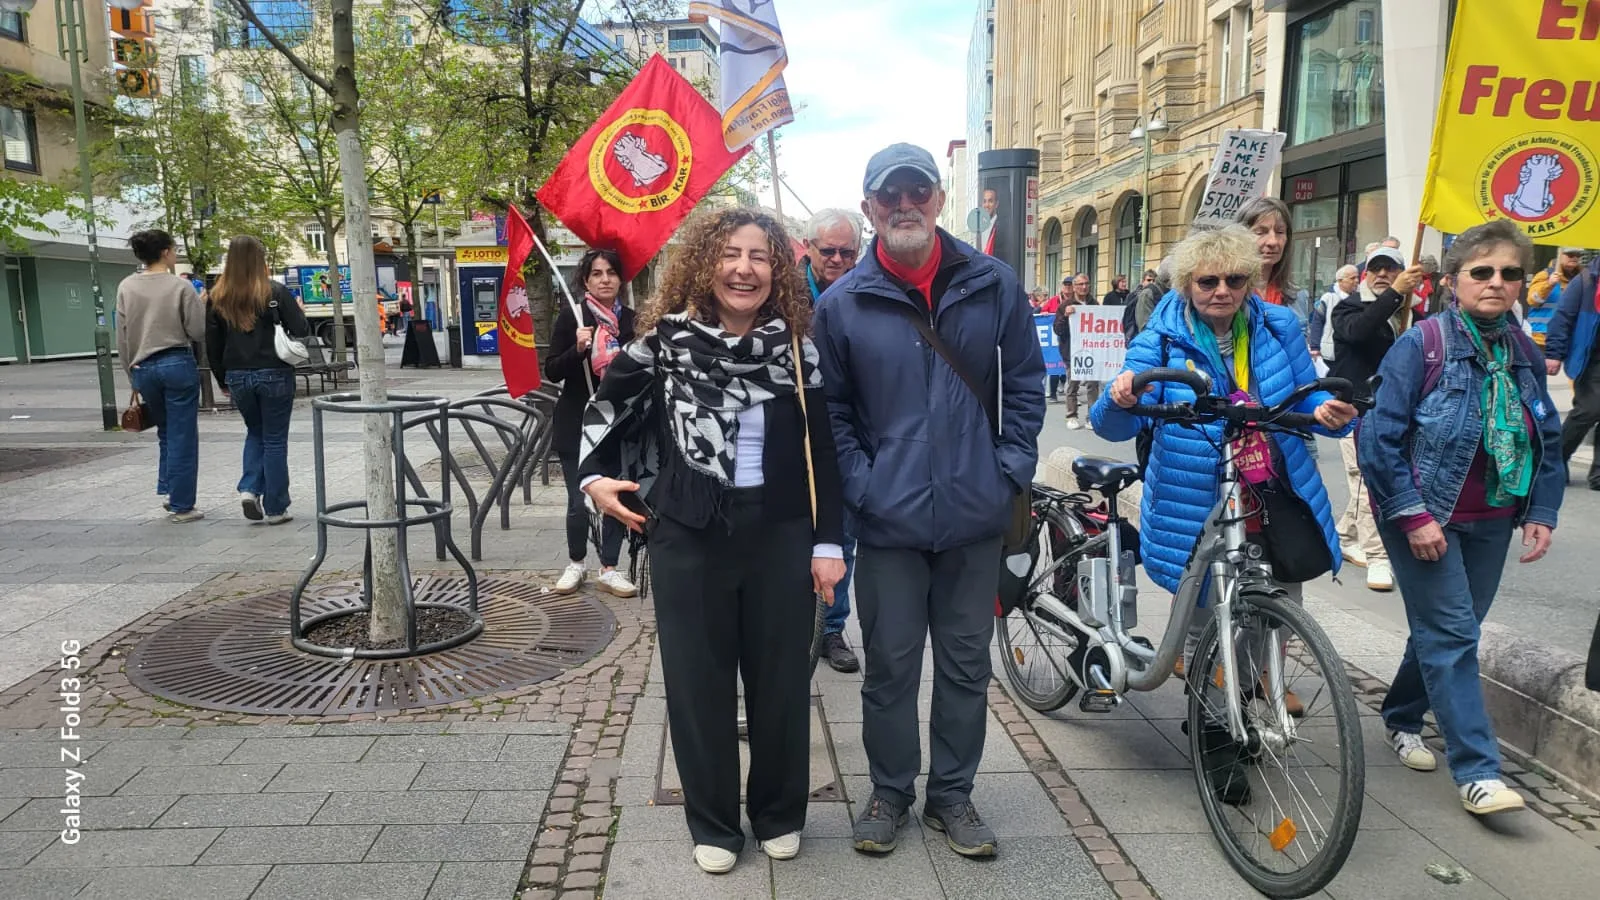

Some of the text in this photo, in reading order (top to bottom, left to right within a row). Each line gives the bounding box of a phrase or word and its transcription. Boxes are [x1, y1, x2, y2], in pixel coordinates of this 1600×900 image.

[1229, 136, 1268, 153] TAKE
[1517, 138, 1529, 147] der
[1531, 136, 1559, 145] Arbeiter
[1235, 153, 1252, 164] ME
[1221, 161, 1259, 177] BACK
[672, 167, 688, 192] KAR
[1240, 179, 1255, 190] THE
[1527, 221, 1555, 234] KAR
[473, 250, 502, 258] LOTTO
[1082, 339, 1110, 349] Hands
[1073, 356, 1094, 368] NO
